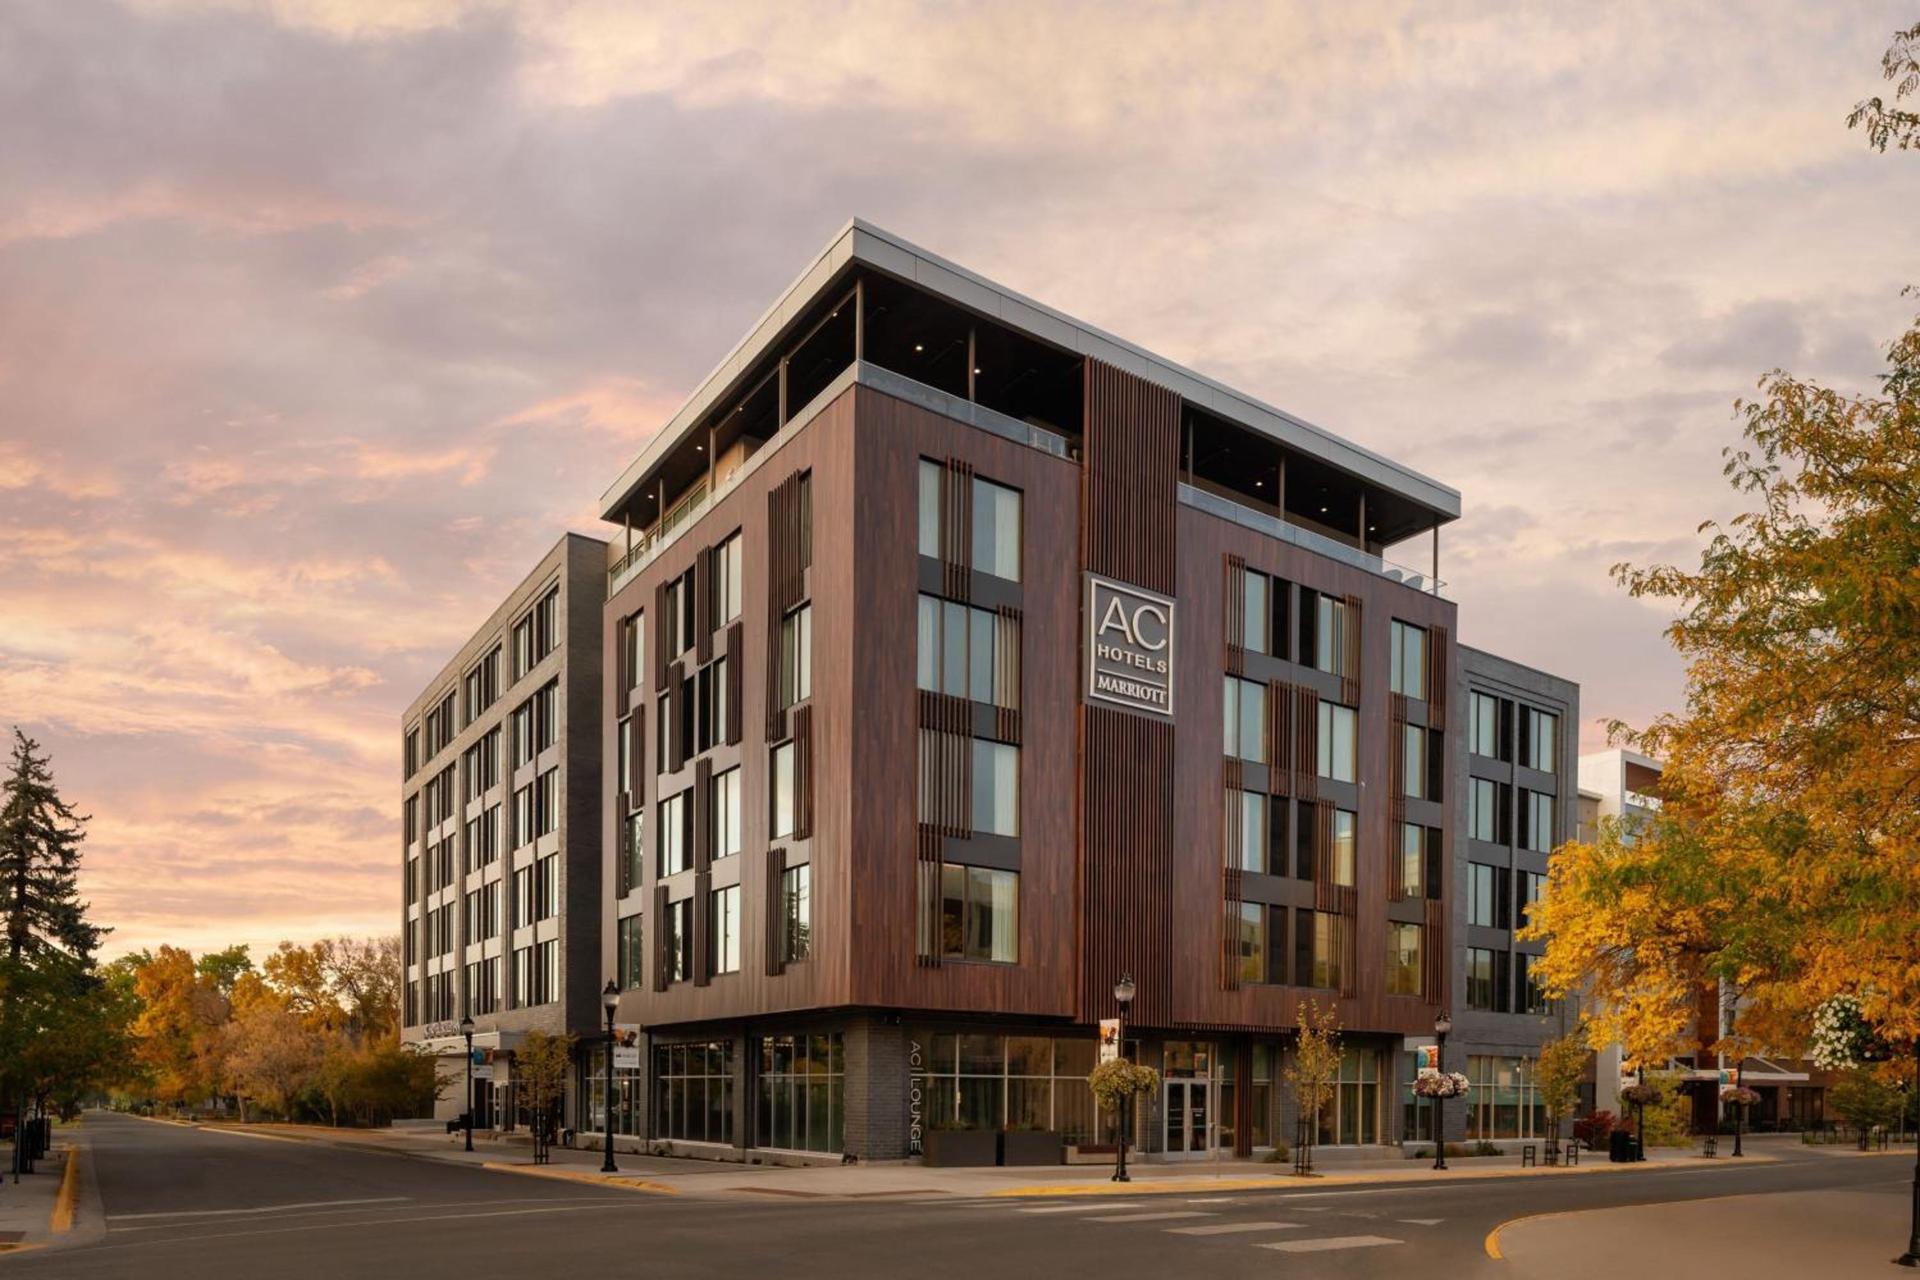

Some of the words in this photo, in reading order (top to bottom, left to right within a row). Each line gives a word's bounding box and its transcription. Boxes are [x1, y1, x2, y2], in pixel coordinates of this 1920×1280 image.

[1098, 596, 1167, 650] AC
[1098, 644, 1167, 673] HOTELS
[1098, 676, 1167, 704] MARRIOTT
[910, 1040, 921, 1066] AC
[910, 1078, 922, 1151] LOUNGE
